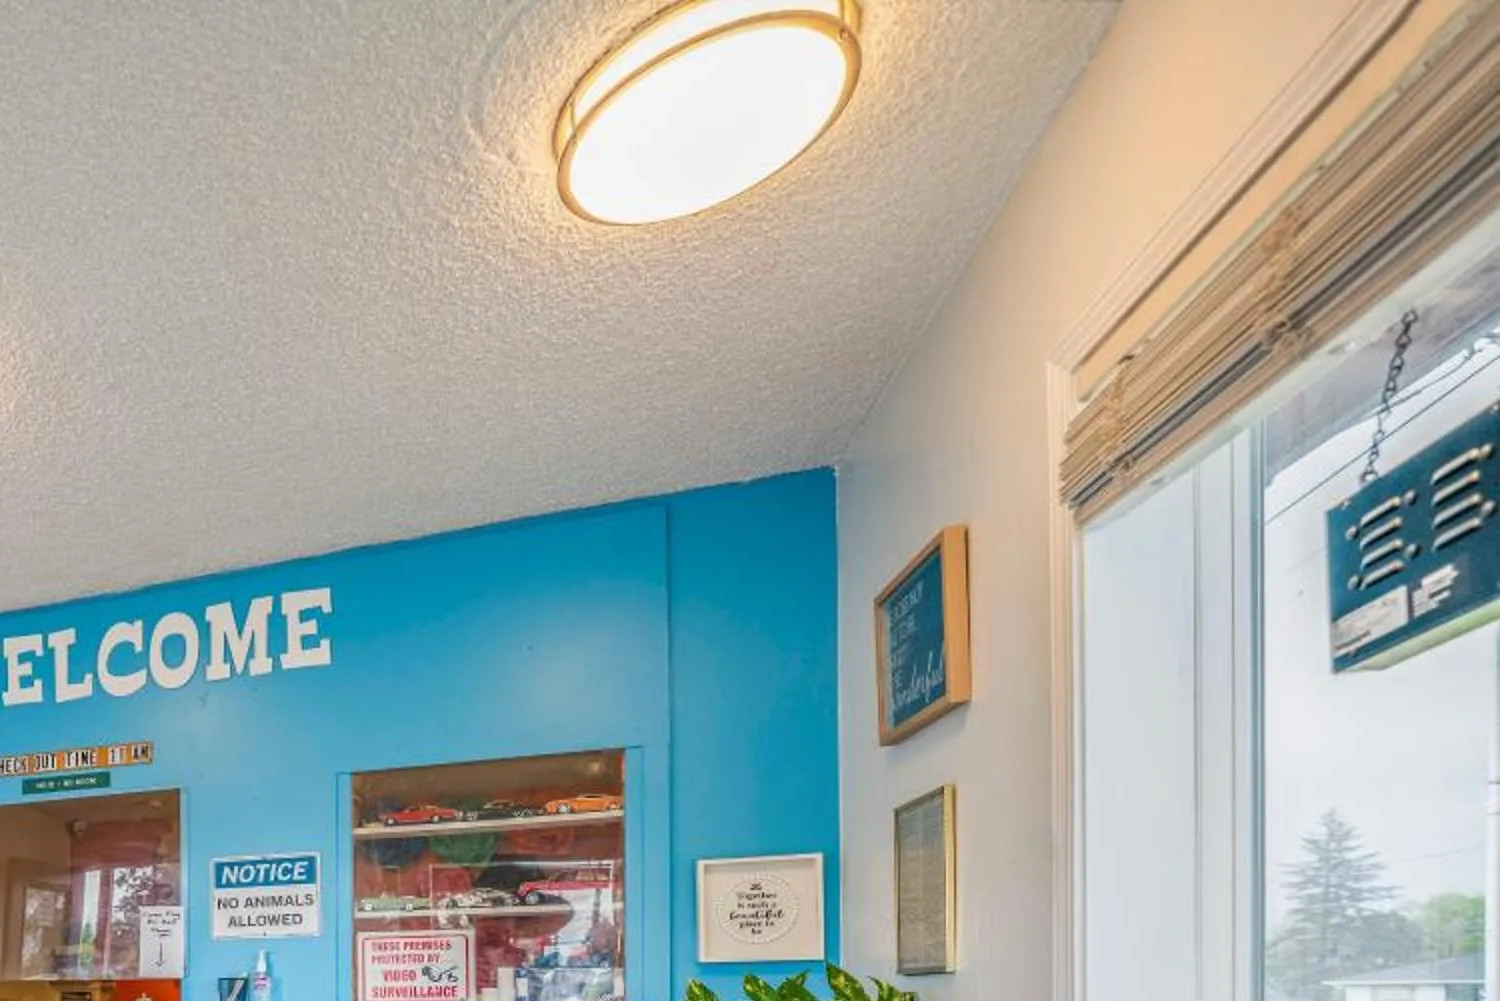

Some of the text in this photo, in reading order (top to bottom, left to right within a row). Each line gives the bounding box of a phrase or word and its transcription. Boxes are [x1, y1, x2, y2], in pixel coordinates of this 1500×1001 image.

[35, 754, 58, 770] OUT
[66, 750, 98, 768] TIME
[221, 861, 309, 884] NOTICE
[217, 893, 315, 911] NO ANIMALS
[227, 913, 304, 928] ALLOWED
[372, 939, 453, 951] THESE PREMISES
[382, 969, 417, 981] VIDEO
[371, 985, 459, 998] SURVEILLANCE
